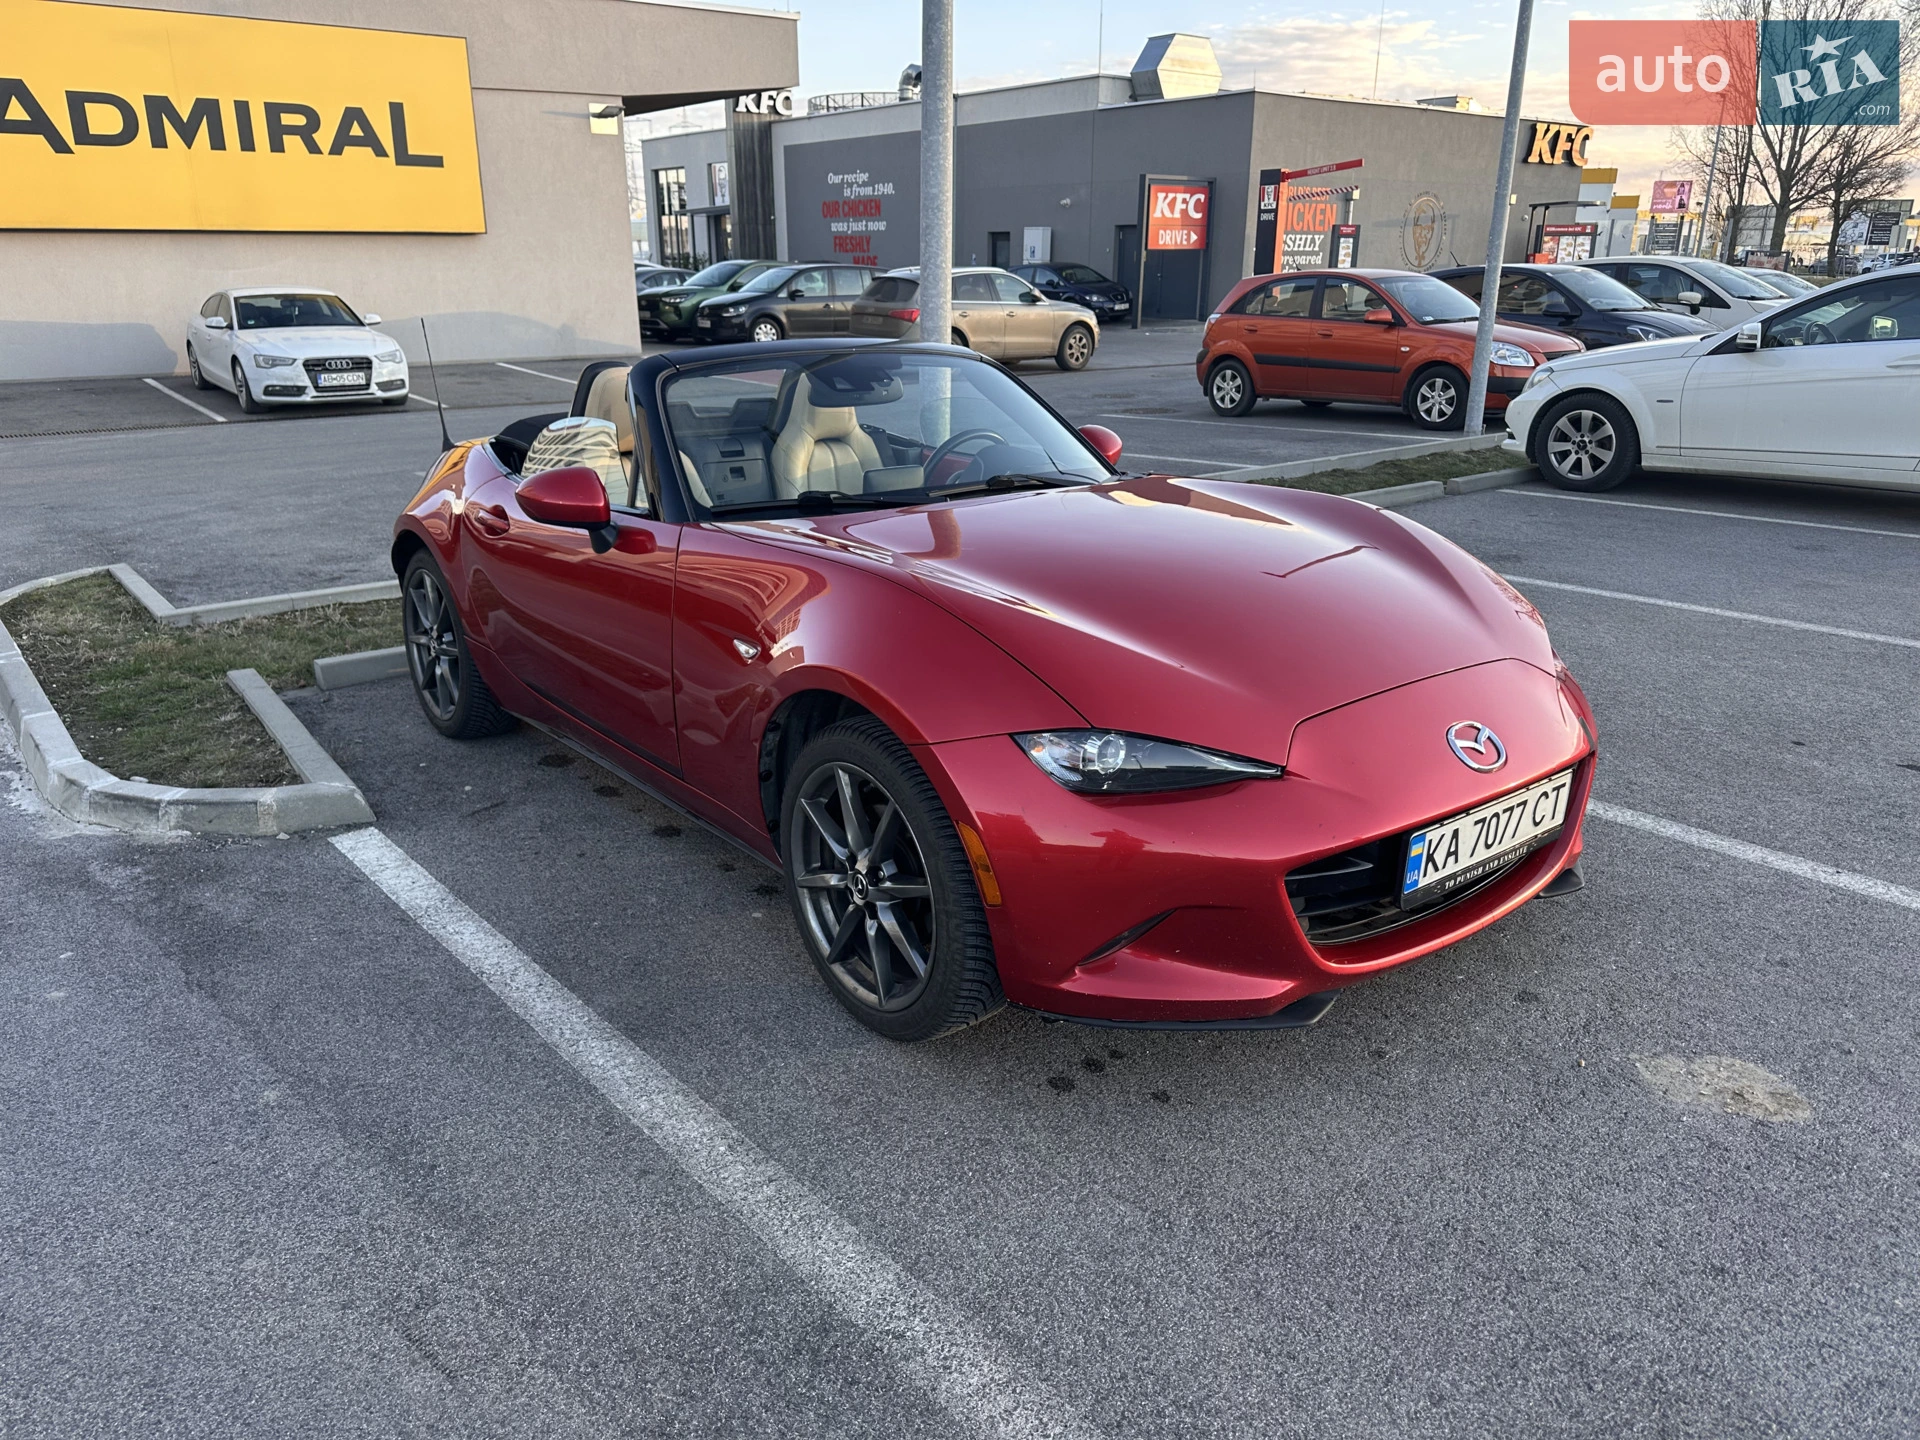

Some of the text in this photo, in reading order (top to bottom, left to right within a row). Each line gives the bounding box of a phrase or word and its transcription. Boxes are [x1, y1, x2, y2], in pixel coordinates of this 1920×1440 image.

[735, 88, 793, 116] KFC
[0, 77, 444, 168] ADMIRAL
[1527, 122, 1594, 167] KFC
[827, 169, 869, 184] Our recipe
[844, 182, 895, 199] is from 1940.
[821, 198, 881, 219] OUR CHICKEN
[1153, 192, 1205, 219] KFC
[831, 218, 887, 234] was just now
[1260, 212, 1275, 221] DRIVE
[1285, 202, 1337, 232] ICKEN
[833, 235, 871, 253] FRESHLY
[1158, 229, 1188, 246] DRIVE
[1423, 782, 1567, 878] KA 7077 CT
[1406, 869, 1419, 884] UA
[1444, 846, 1529, 890] TO PUNISH AND ENSLAVE
